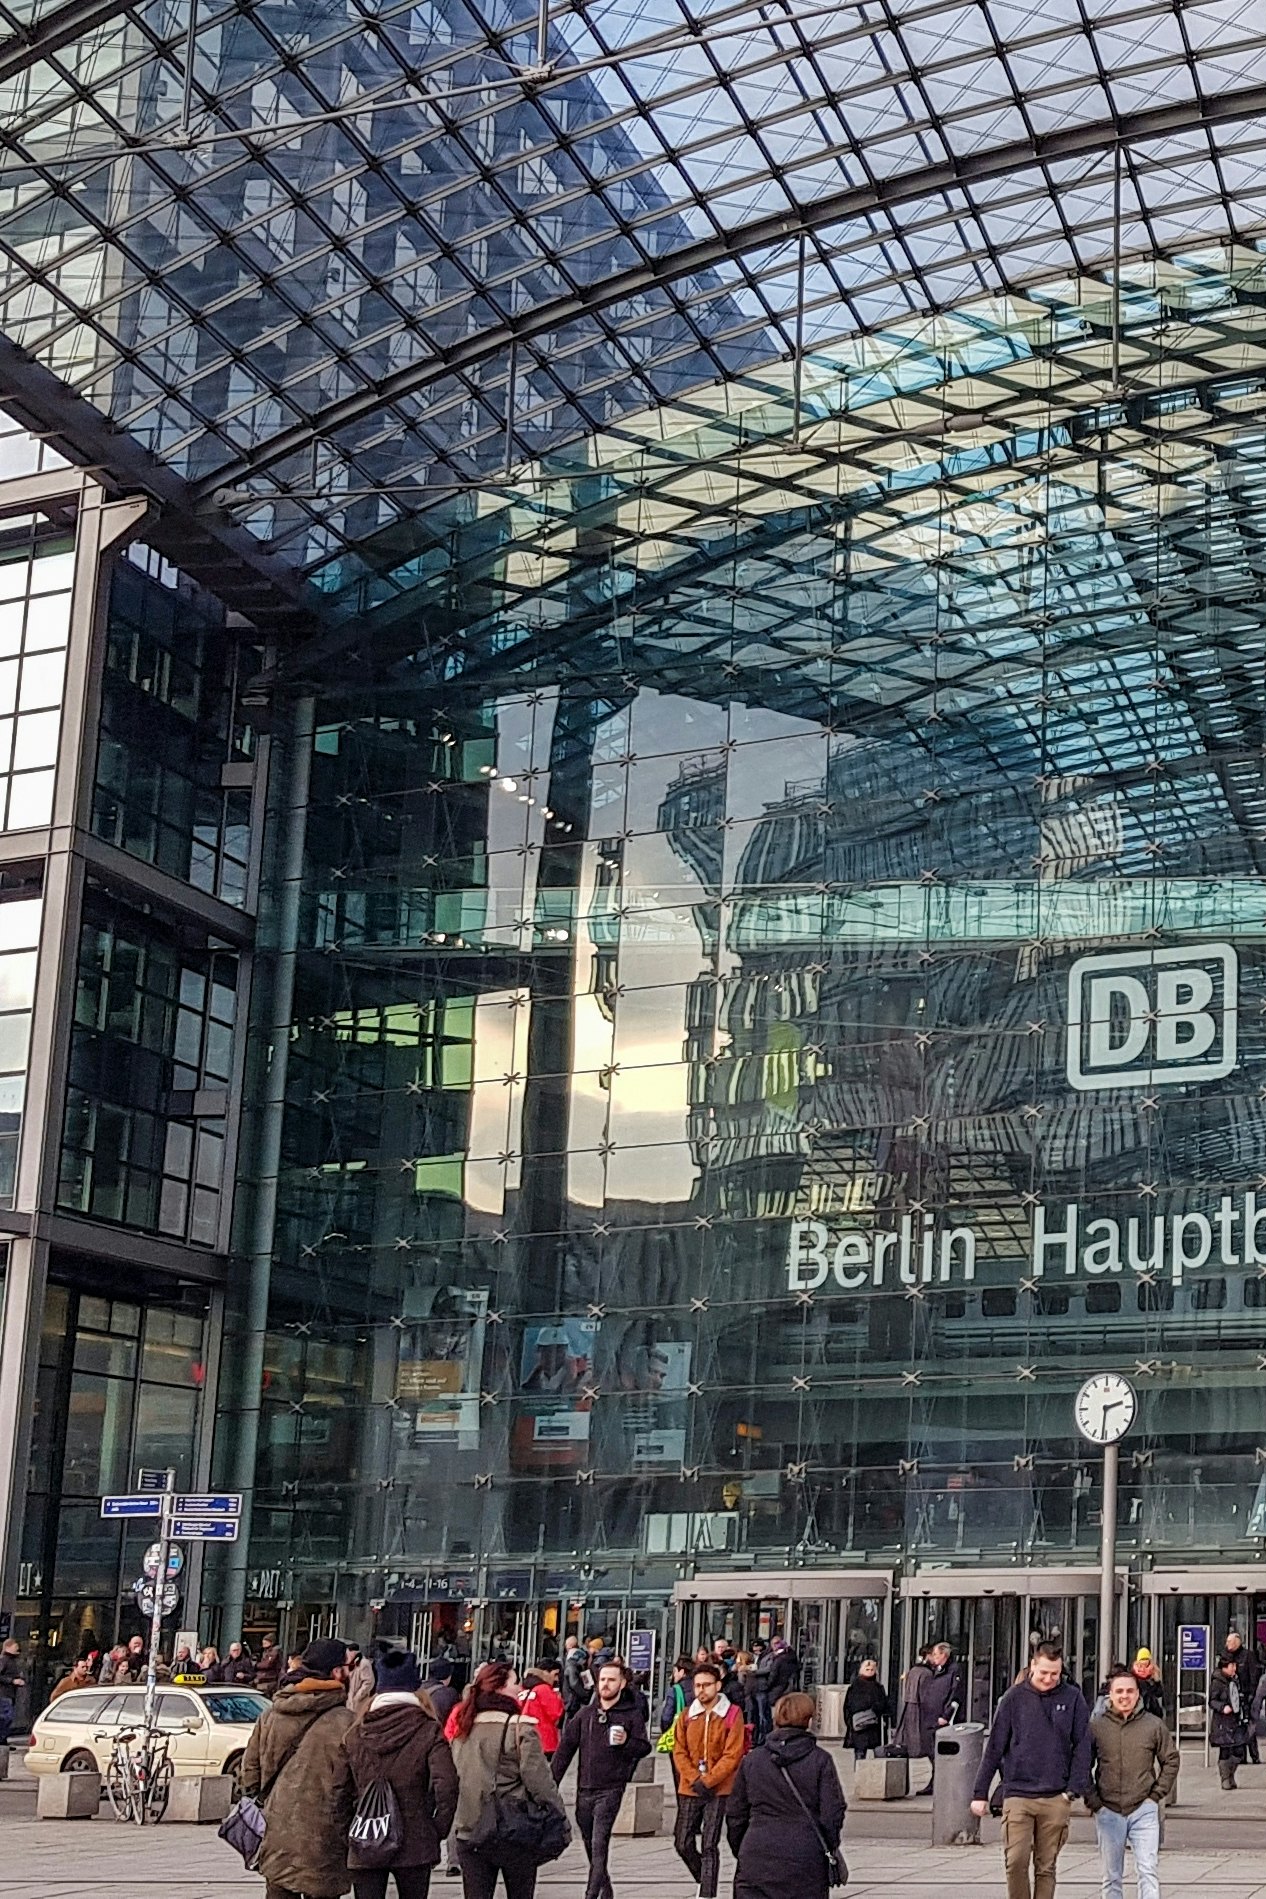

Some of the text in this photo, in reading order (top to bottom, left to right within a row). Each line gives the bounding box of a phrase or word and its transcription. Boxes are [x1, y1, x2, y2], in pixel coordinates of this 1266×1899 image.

[1088, 968, 1217, 1067] DB
[788, 1212, 976, 1291] Berlin
[348, 1813, 391, 1840] MW
